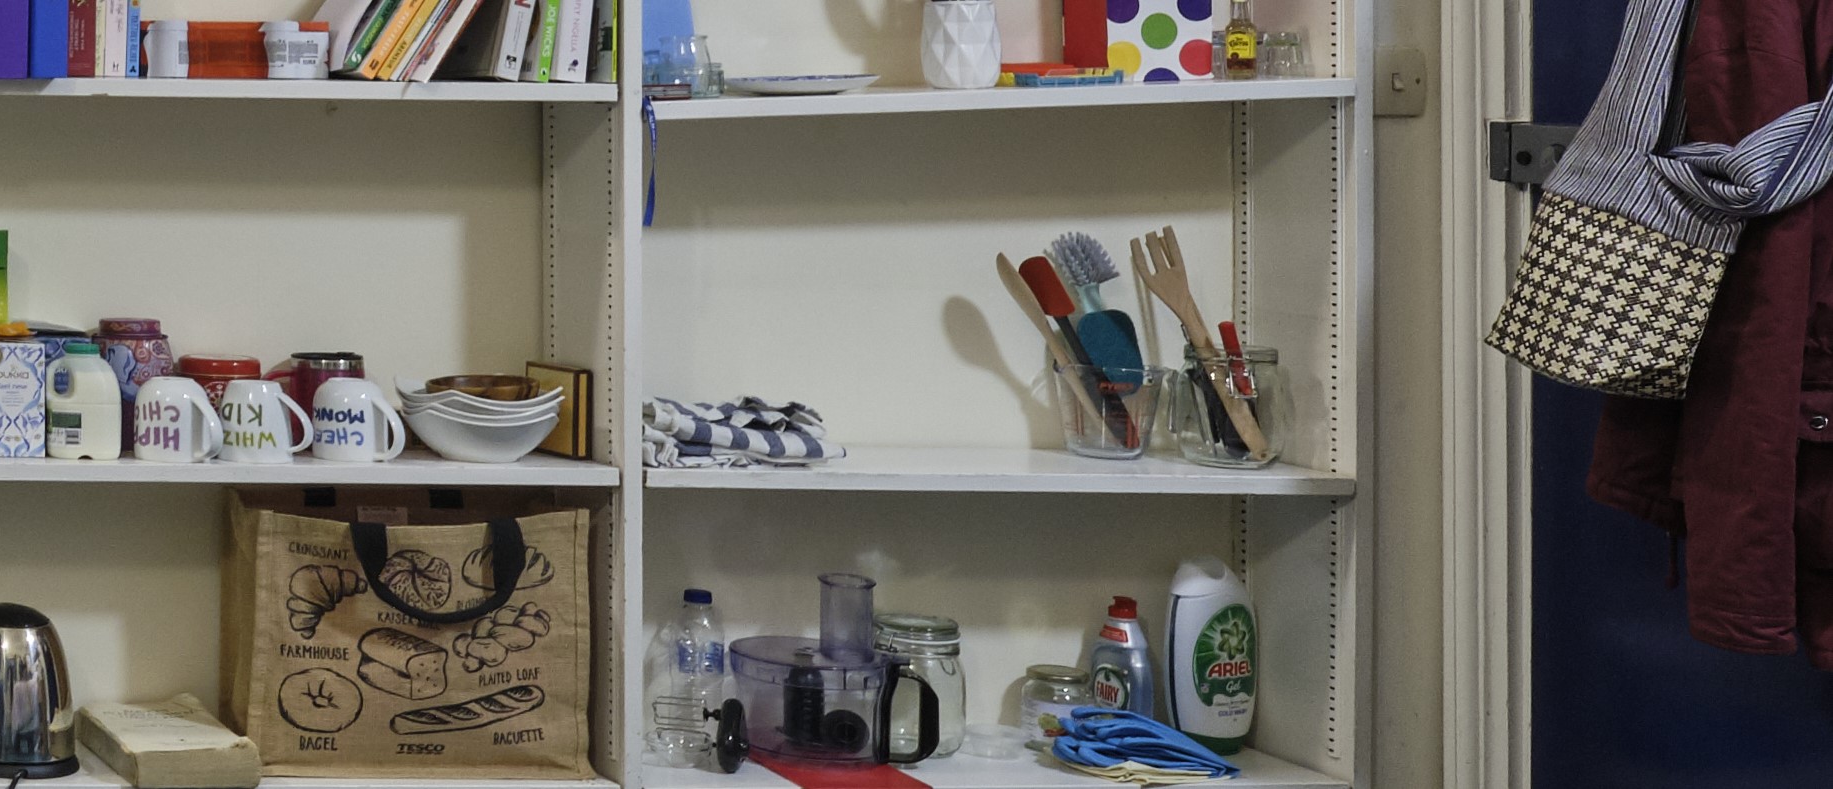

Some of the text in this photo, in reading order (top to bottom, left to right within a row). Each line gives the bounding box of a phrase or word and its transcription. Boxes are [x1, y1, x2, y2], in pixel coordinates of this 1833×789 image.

[541, 5, 557, 57] JOE WICKS
[570, 18, 581, 52] NIGELLA
[222, 403, 262, 426] KID
[314, 406, 367, 425] MONK
[134, 426, 179, 451] HIPP
[223, 432, 277, 449] WHIZ
[314, 427, 365, 447] CHEE
[288, 541, 350, 560] CROISSANT
[377, 611, 417, 625] KAISER
[280, 644, 350, 661] FARMHOUSE
[478, 667, 541, 688] PLAITED LOAF
[1207, 660, 1252, 678] ARIEL
[1095, 680, 1120, 704] FAIRY
[1225, 680, 1242, 693] Gel
[299, 735, 337, 751] BAGEL
[493, 728, 545, 745] BAGUETTE
[396, 743, 445, 754] TESCO
